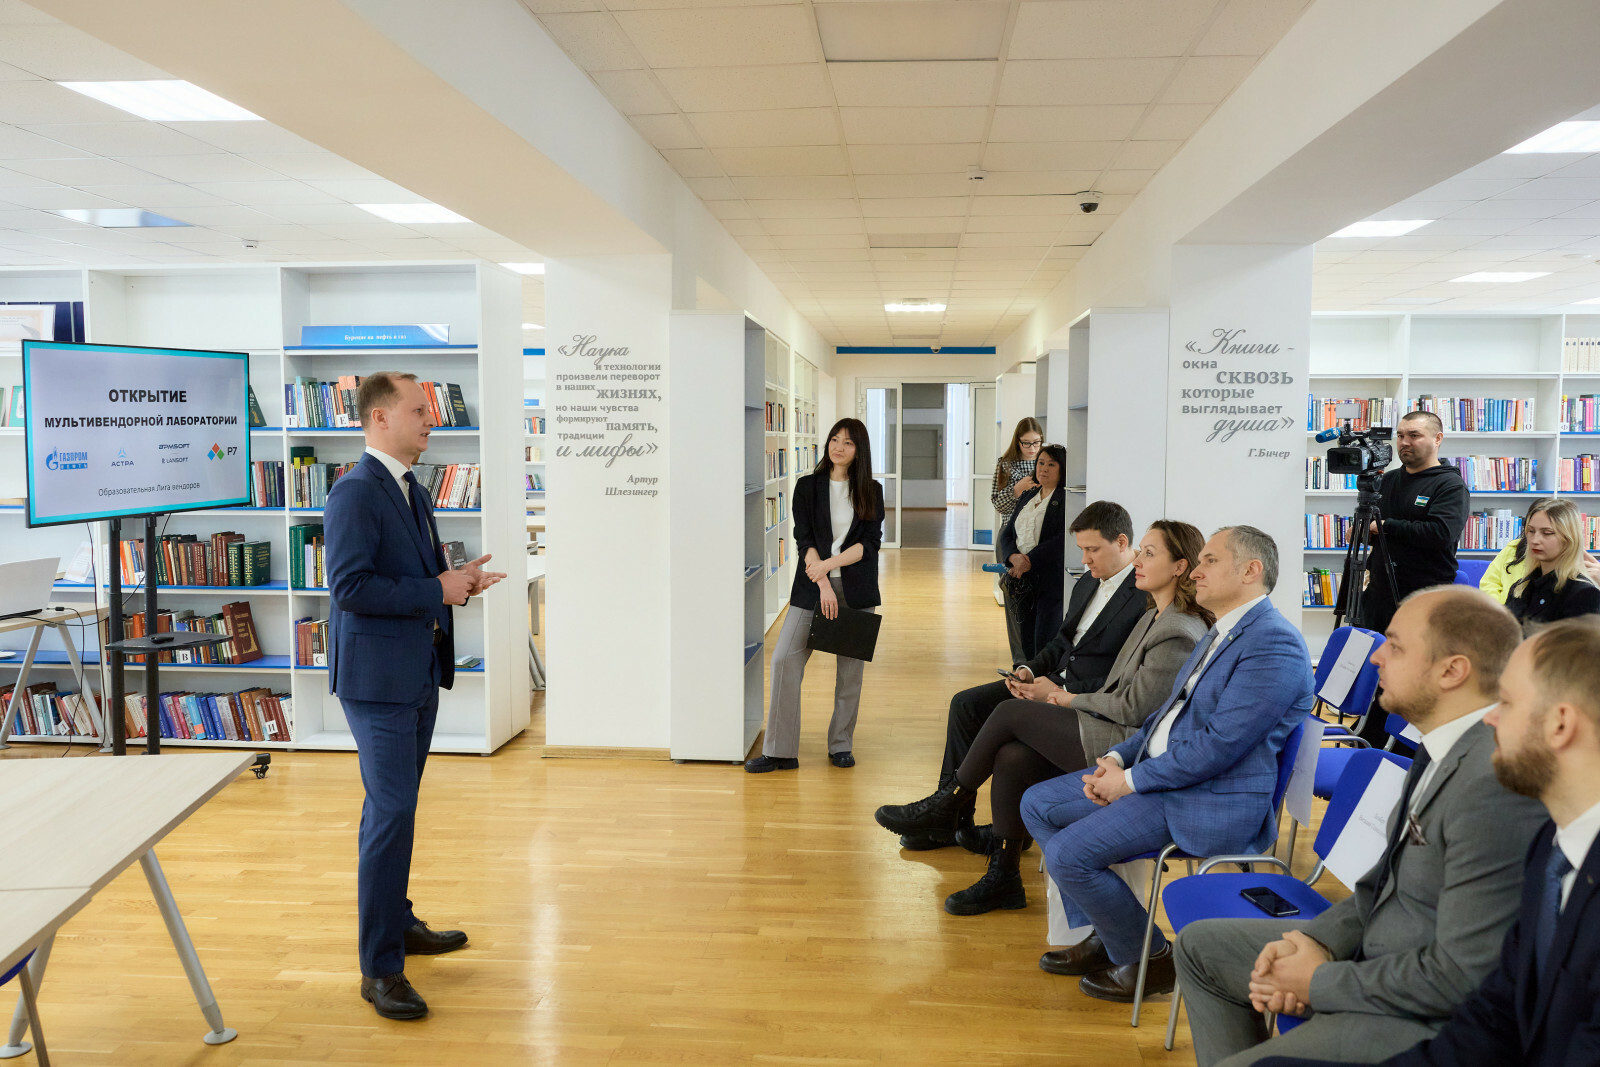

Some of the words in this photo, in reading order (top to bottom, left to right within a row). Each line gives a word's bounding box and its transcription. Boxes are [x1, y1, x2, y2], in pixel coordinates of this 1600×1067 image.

[1182, 360, 1218, 369] окна
[1216, 371, 1294, 384] сквозь
[108, 389, 187, 403] ОТКРЫТИЕ
[596, 389, 662, 402] жизнях,
[1182, 388, 1255, 401] которые
[600, 404, 639, 413] чувства
[1182, 405, 1283, 415] выглядывает
[44, 414, 164, 429] МУЛЬТИВЕНДОРНОЙ
[166, 416, 237, 426] ЛАБОРАТОРИИ
[556, 415, 608, 424] формируют
[606, 422, 658, 433] память,
[1205, 416, 1295, 443] душа»
[557, 432, 604, 440] традиции
[556, 445, 572, 457] и
[576, 433, 658, 468] мифы»
[1248, 448, 1290, 459] Г.Бичер
[59, 452, 88, 462] ГАЗПРОМ
[627, 474, 658, 485] Артур
[98, 487, 155, 498] Образовательная
[605, 487, 658, 498] Шлезингер
